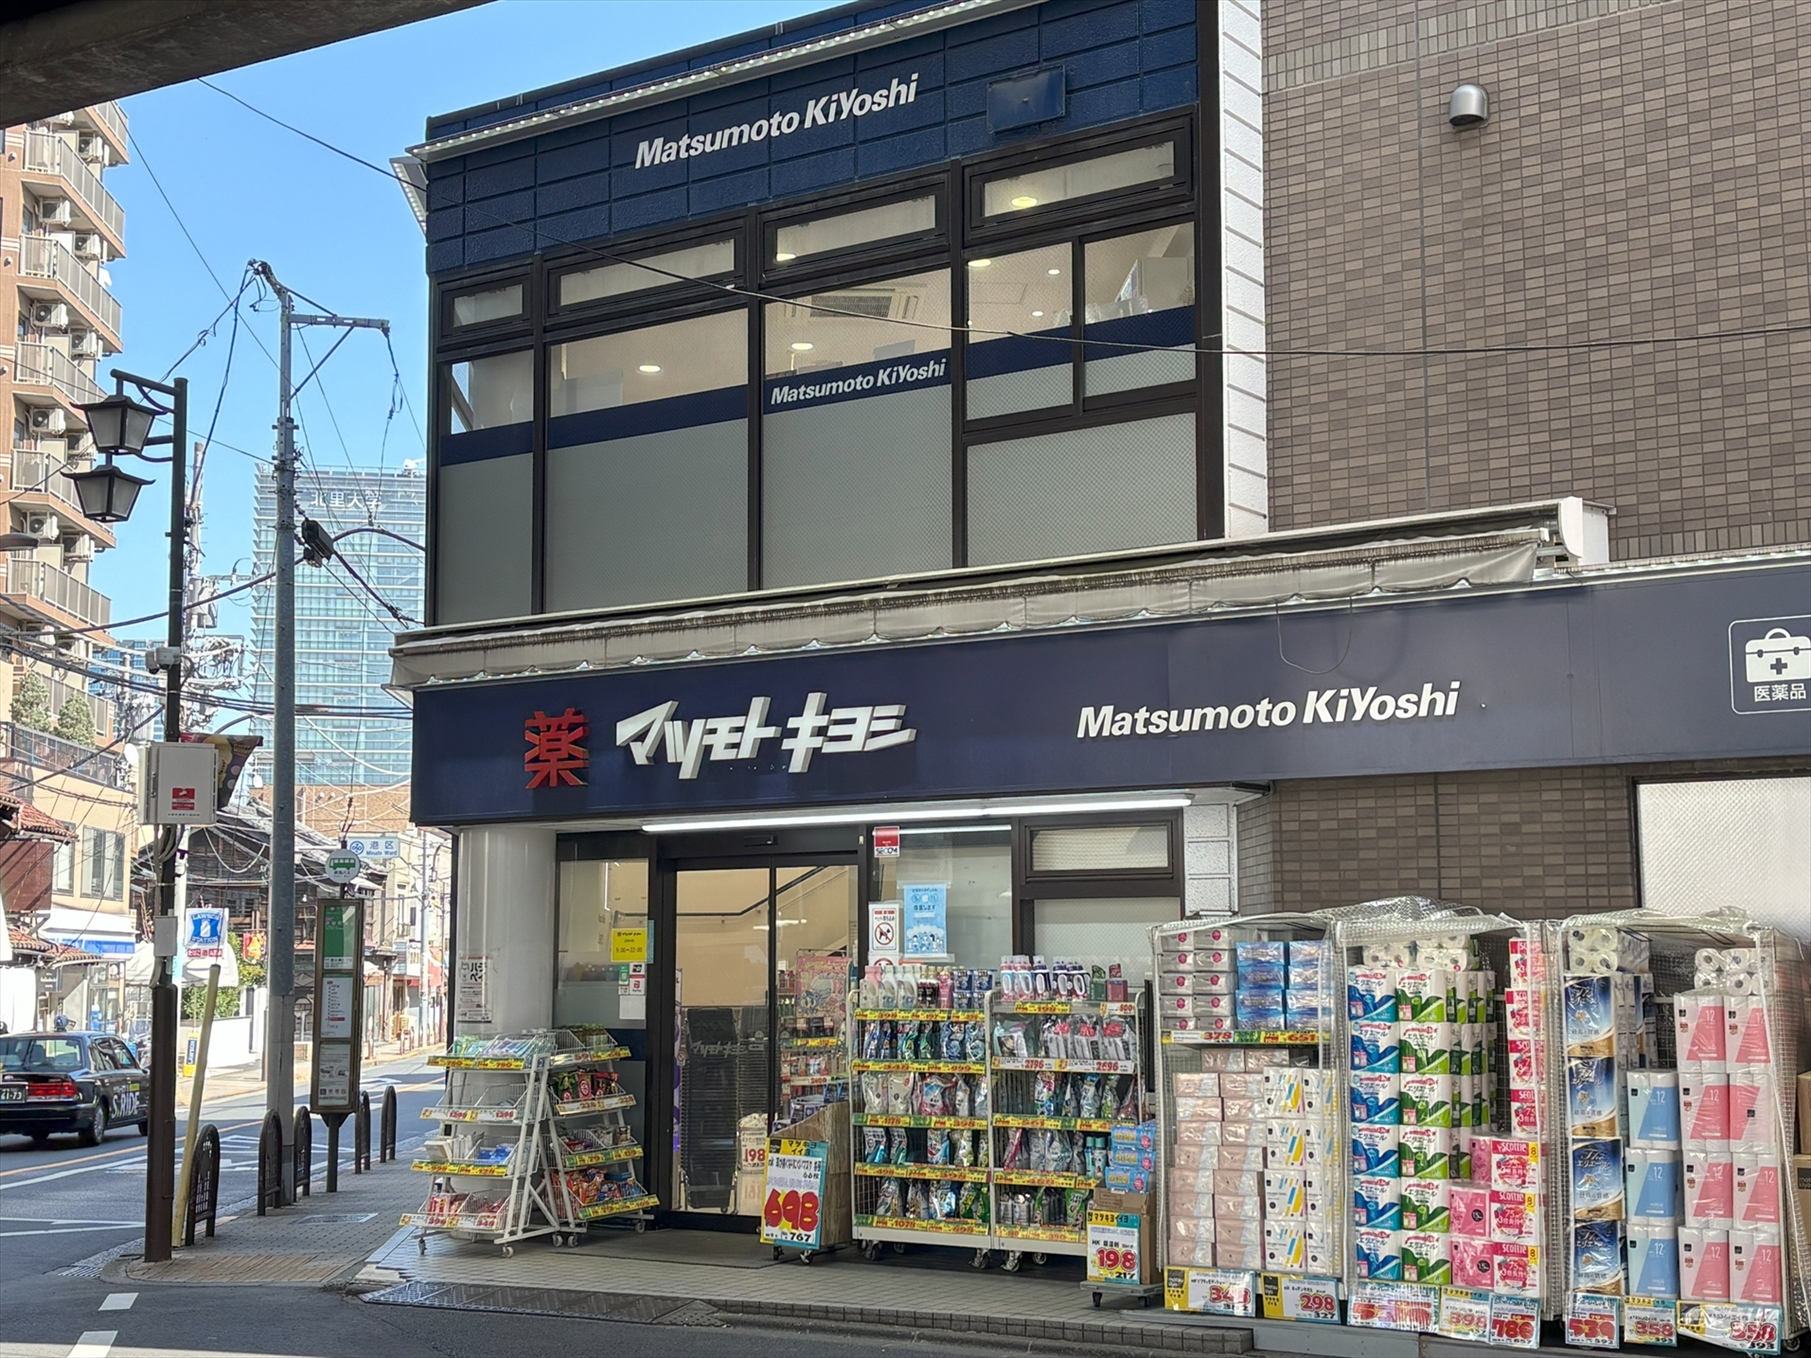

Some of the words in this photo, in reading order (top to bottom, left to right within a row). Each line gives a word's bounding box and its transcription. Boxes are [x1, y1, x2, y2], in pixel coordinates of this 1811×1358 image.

[635, 108, 800, 169] Matsumoto
[804, 73, 919, 128] KiYoshi
[770, 371, 874, 405] Matsumoto
[876, 359, 947, 387] KiYoshi
[311, 490, 382, 509] 北里大学
[1753, 683, 1806, 702] 医薬品
[1076, 696, 1296, 738] Matsumoto
[1302, 682, 1461, 724] KiYoshi
[525, 707, 589, 789] 薬
[616, 691, 917, 779] マツモトキヨシ
[1706, 1010, 1715, 1023] 12
[1288, 1034, 1316, 1042] 651
[1656, 1090, 1665, 1102] 12
[1709, 1089, 1719, 1101] 12
[788, 1140, 817, 1149] マツキヨ
[744, 1149, 766, 1162] 198
[1653, 1166, 1662, 1179] 12
[1765, 1171, 1774, 1183] 12
[764, 1188, 820, 1232] 698
[895, 1220, 916, 1228] 1078
[790, 1232, 811, 1242] 767
[1654, 1243, 1664, 1256] 12
[1711, 1246, 1721, 1259] 12
[1762, 1249, 1771, 1262] 12
[1096, 1247, 1137, 1272] 198
[1300, 1292, 1336, 1312] 298
[1314, 1311, 1336, 1319] 327
[1448, 1311, 1488, 1329] 398
[1569, 1318, 1615, 1340] 539
[1635, 1321, 1675, 1337] 358
[1730, 1320, 1777, 1342] 358
